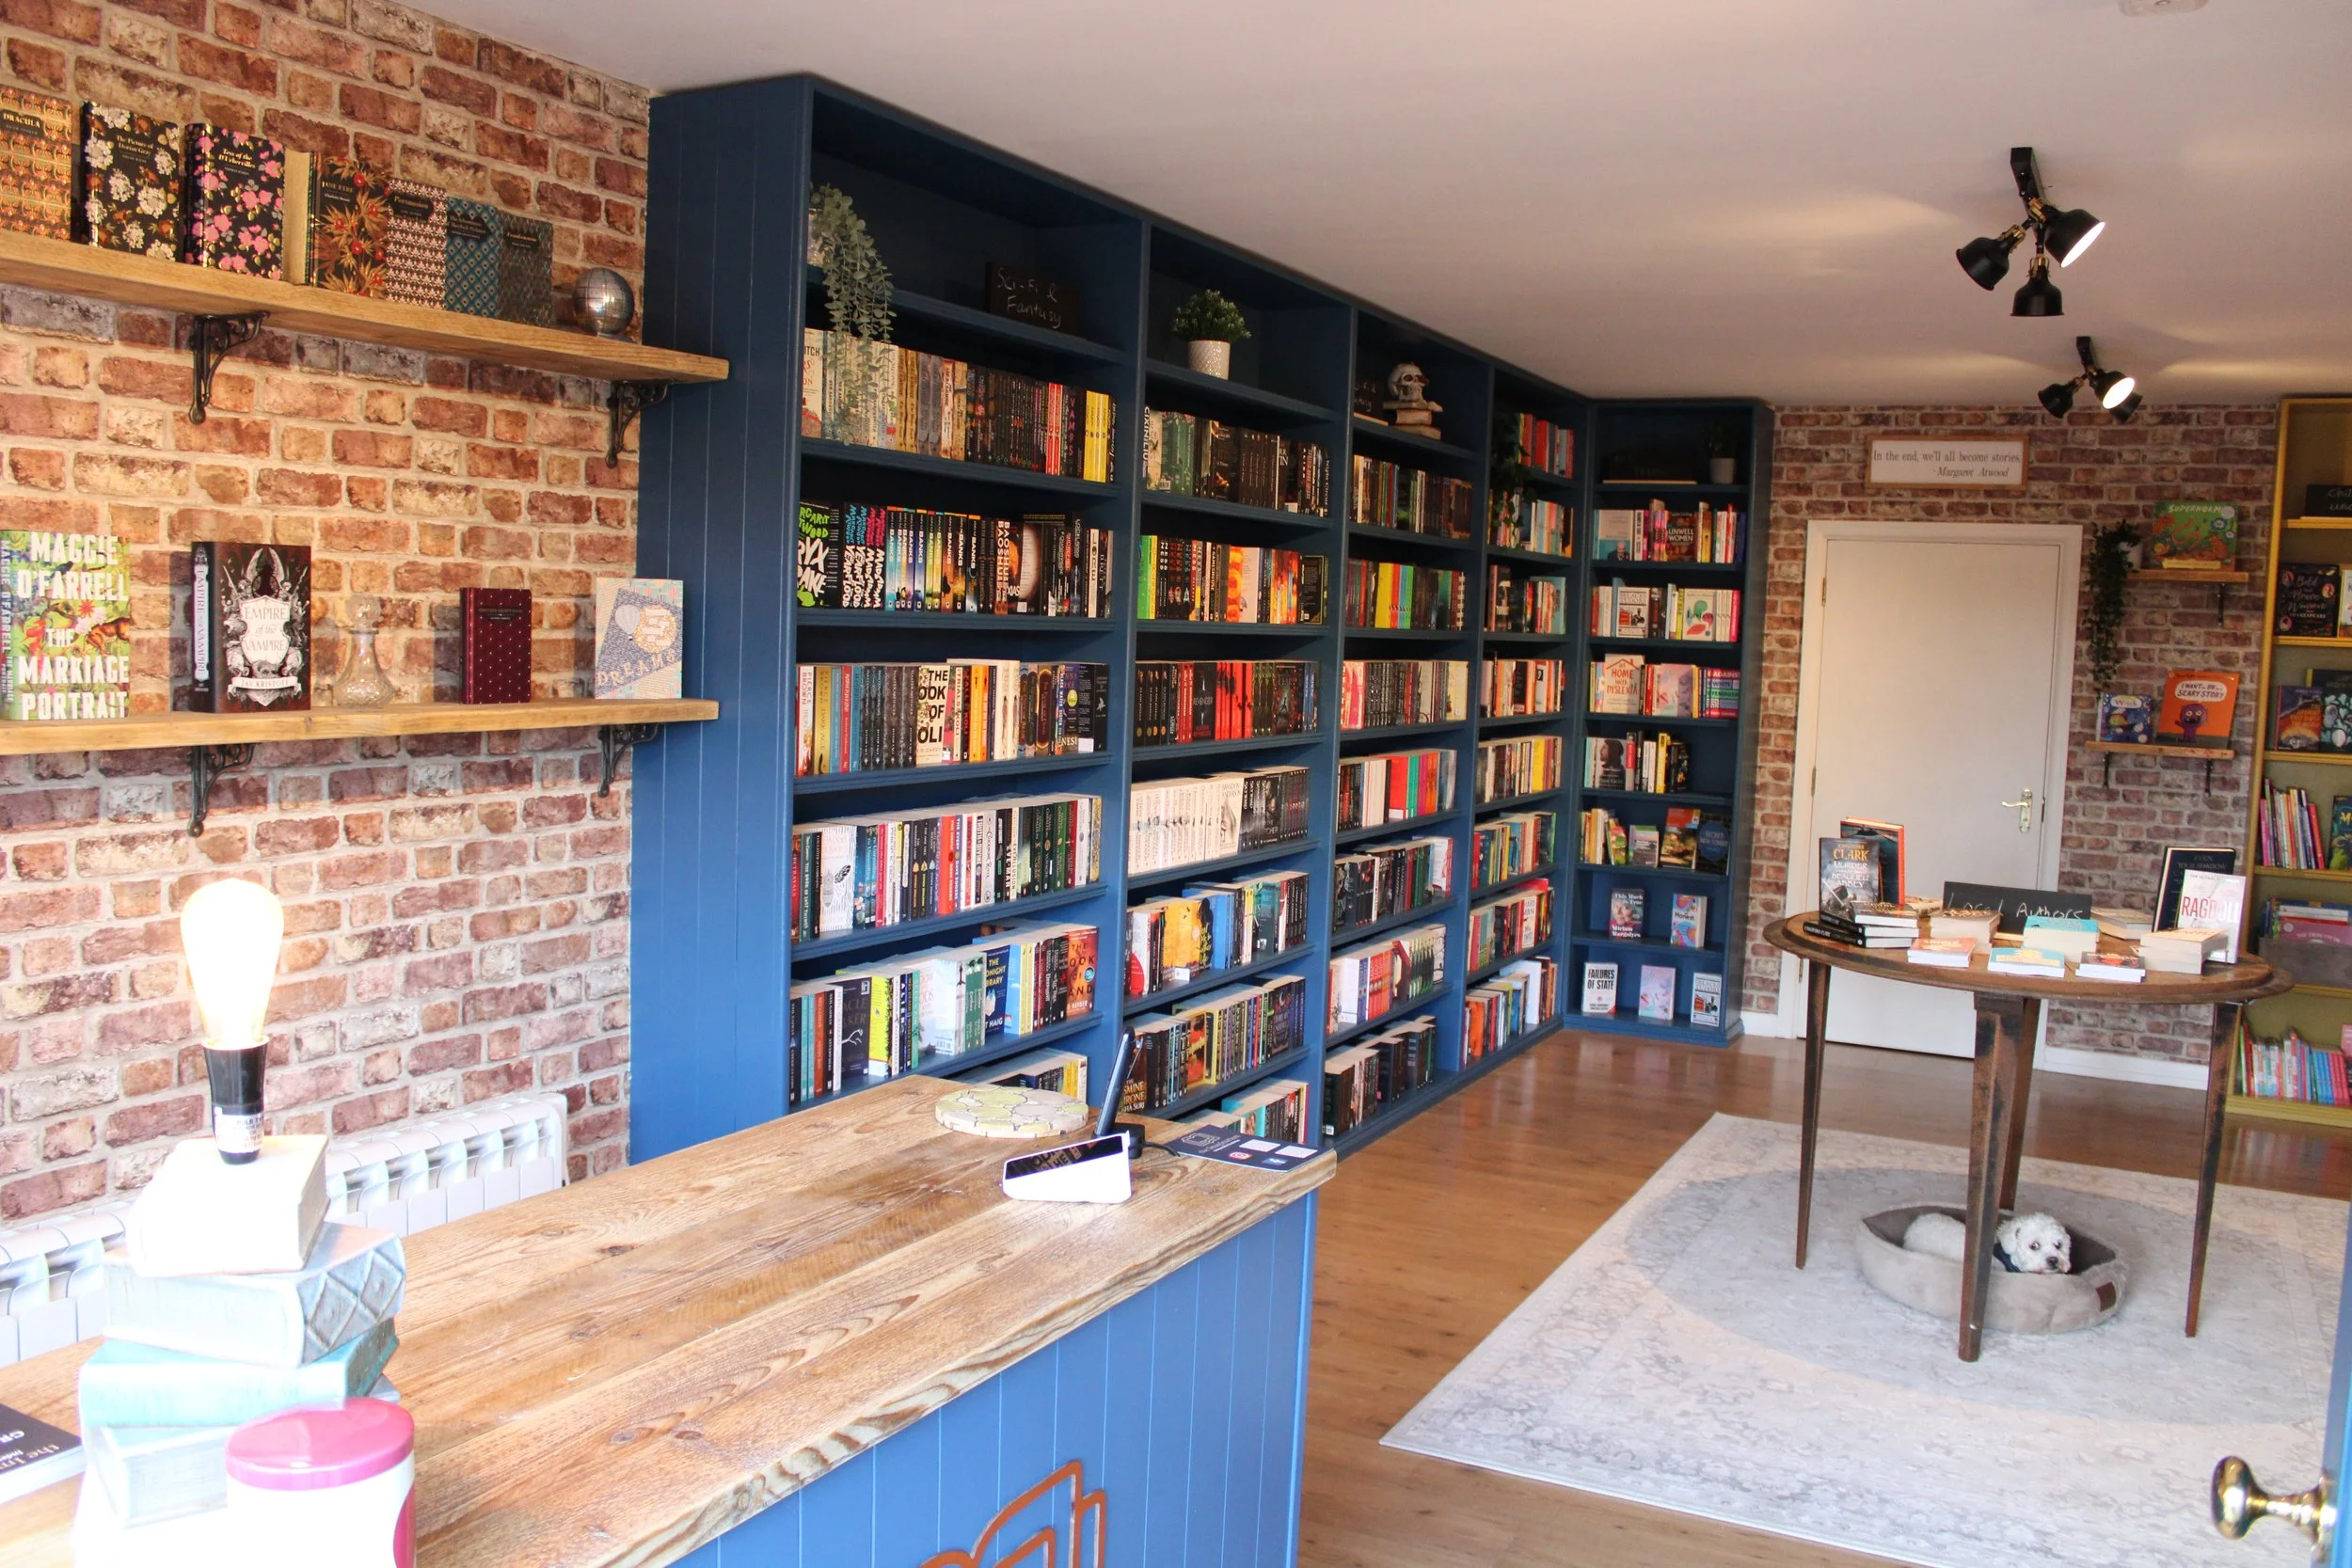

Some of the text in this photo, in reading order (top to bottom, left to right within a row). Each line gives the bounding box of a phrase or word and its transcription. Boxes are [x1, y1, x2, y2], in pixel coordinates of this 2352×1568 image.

[3, 110, 41, 129] DRACULA
[1007, 294, 1061, 330] Fantasy
[1873, 450, 1882, 461] In
[1885, 451, 1899, 461] the
[1901, 451, 1919, 463] end,
[1922, 451, 1941, 461] we'll
[1944, 451, 1955, 462] all
[1959, 451, 1989, 462] become
[1979, 467, 2010, 478] Atwood
[800, 507, 830, 525] RGARET
[799, 517, 829, 538] TWOOD
[30, 531, 119, 565] MAGGIE
[798, 537, 829, 573] RYX
[1, 539, 10, 586] MAGGIE
[17, 569, 130, 602] O'FARRELL
[245, 606, 287, 621] EMPIRE
[1687, 610, 1714, 619] Listen
[197, 570, 205, 674] EMPIRE VAMPIRE
[255, 625, 276, 636] of the
[45, 627, 76, 648] THE
[244, 639, 285, 652] VAMPIRE
[18, 655, 130, 685] MARRIAGE
[596, 648, 675, 687] DREAMS
[1611, 669, 1634, 679] HOME
[929, 670, 948, 681] THE
[256, 679, 292, 688] KRISTOFF
[1607, 684, 1639, 695] DYSLEXIA
[918, 686, 946, 700] OOK
[2176, 689, 2224, 699] SCARY STORY
[22, 691, 129, 721] PORTRAIT
[929, 705, 945, 720] OF
[917, 725, 943, 744] OLI
[1061, 736, 1078, 746] NESI
[1833, 847, 1869, 861] CLARK
[1834, 861, 1868, 870] MURDER
[2016, 902, 2083, 920] Authors
[1072, 942, 1087, 951] THE
[989, 957, 999, 966] THE
[1070, 955, 1095, 967] OOK
[1587, 968, 1615, 980] FAILURES
[1069, 985, 1093, 997] AND
[1587, 980, 1614, 990] OF STATE
[990, 1017, 1003, 1028] HAIG
[1124, 1081, 1145, 1093] SMINE
